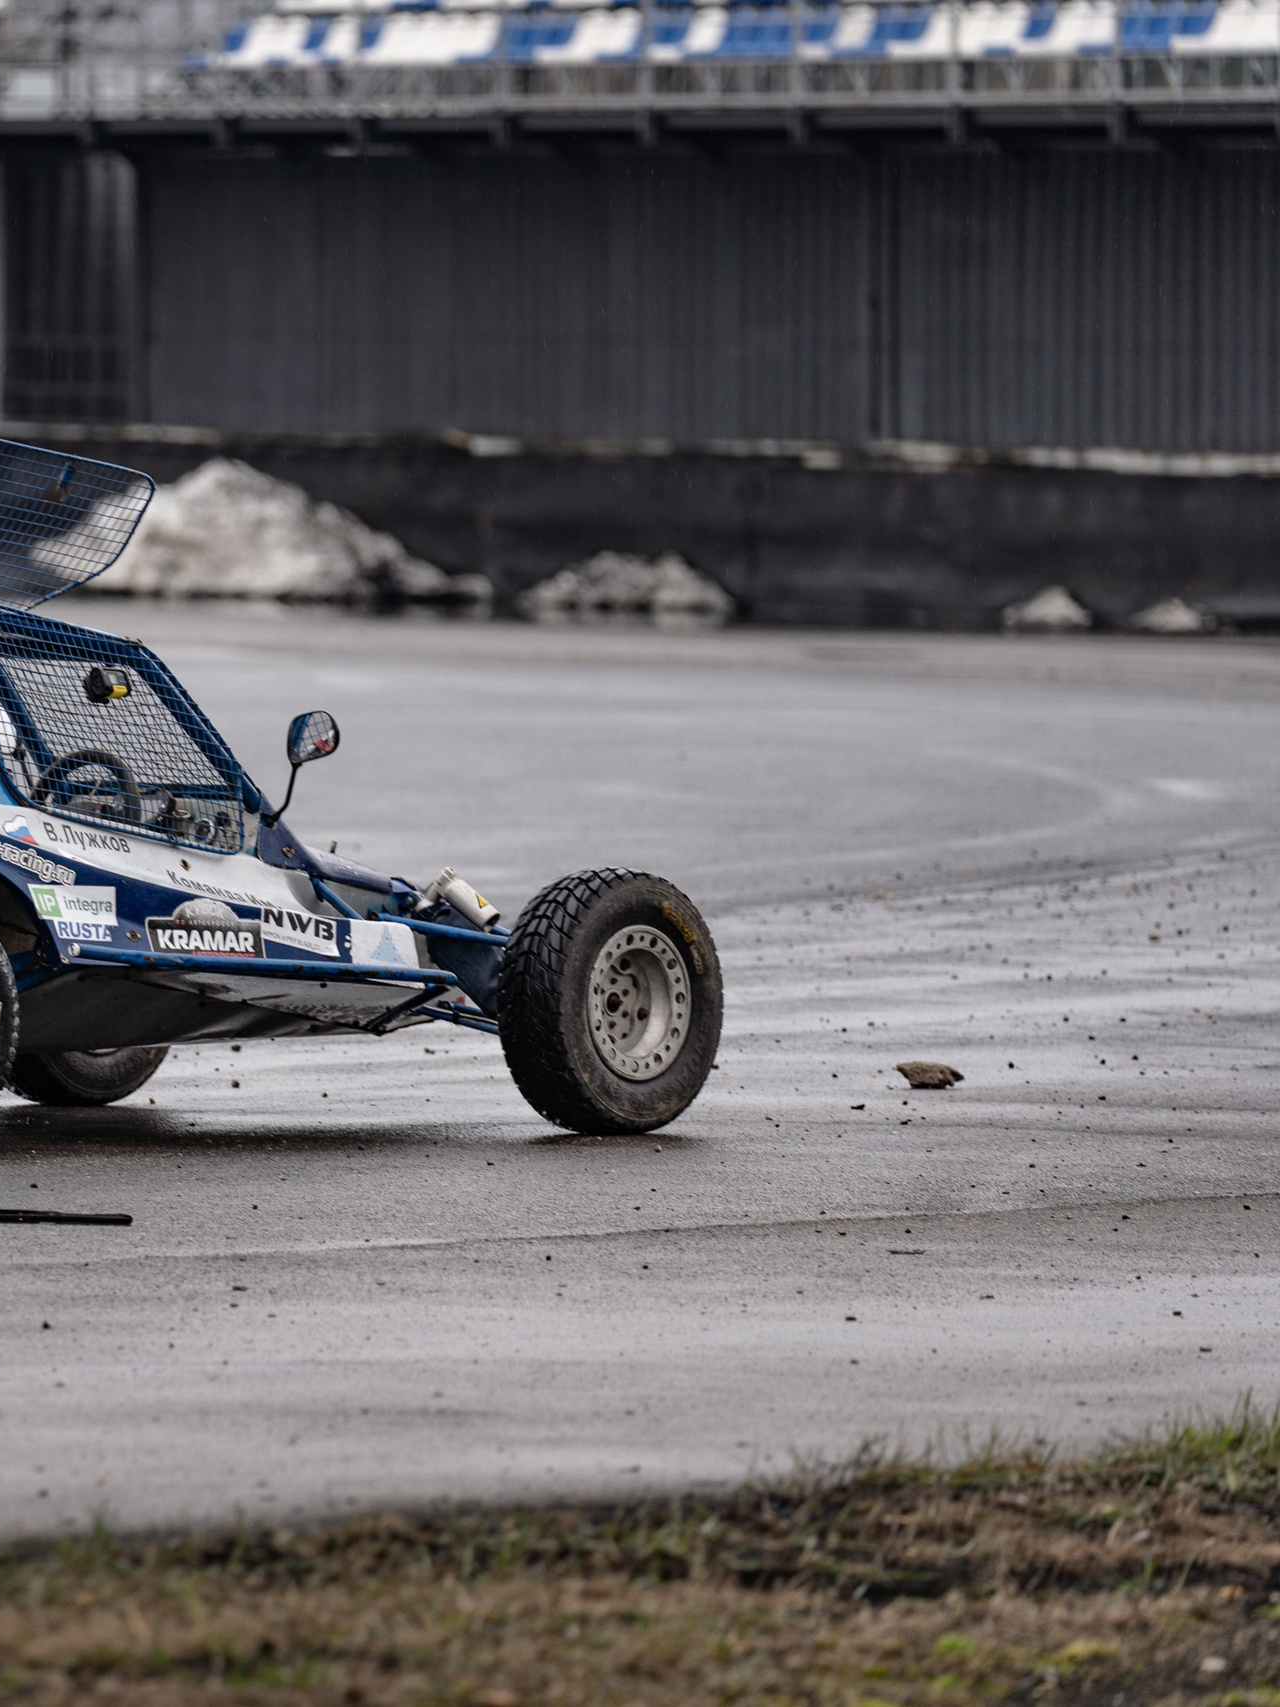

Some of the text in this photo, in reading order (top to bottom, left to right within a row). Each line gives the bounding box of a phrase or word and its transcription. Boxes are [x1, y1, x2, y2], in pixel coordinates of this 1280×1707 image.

[43, 821, 130, 853] В.Лужков
[167, 869, 246, 901] Команда
[36, 892, 113, 916] IP integra
[58, 921, 112, 940] RUSTA
[263, 908, 333, 941] NWB
[157, 929, 256, 953] KRAMAR
